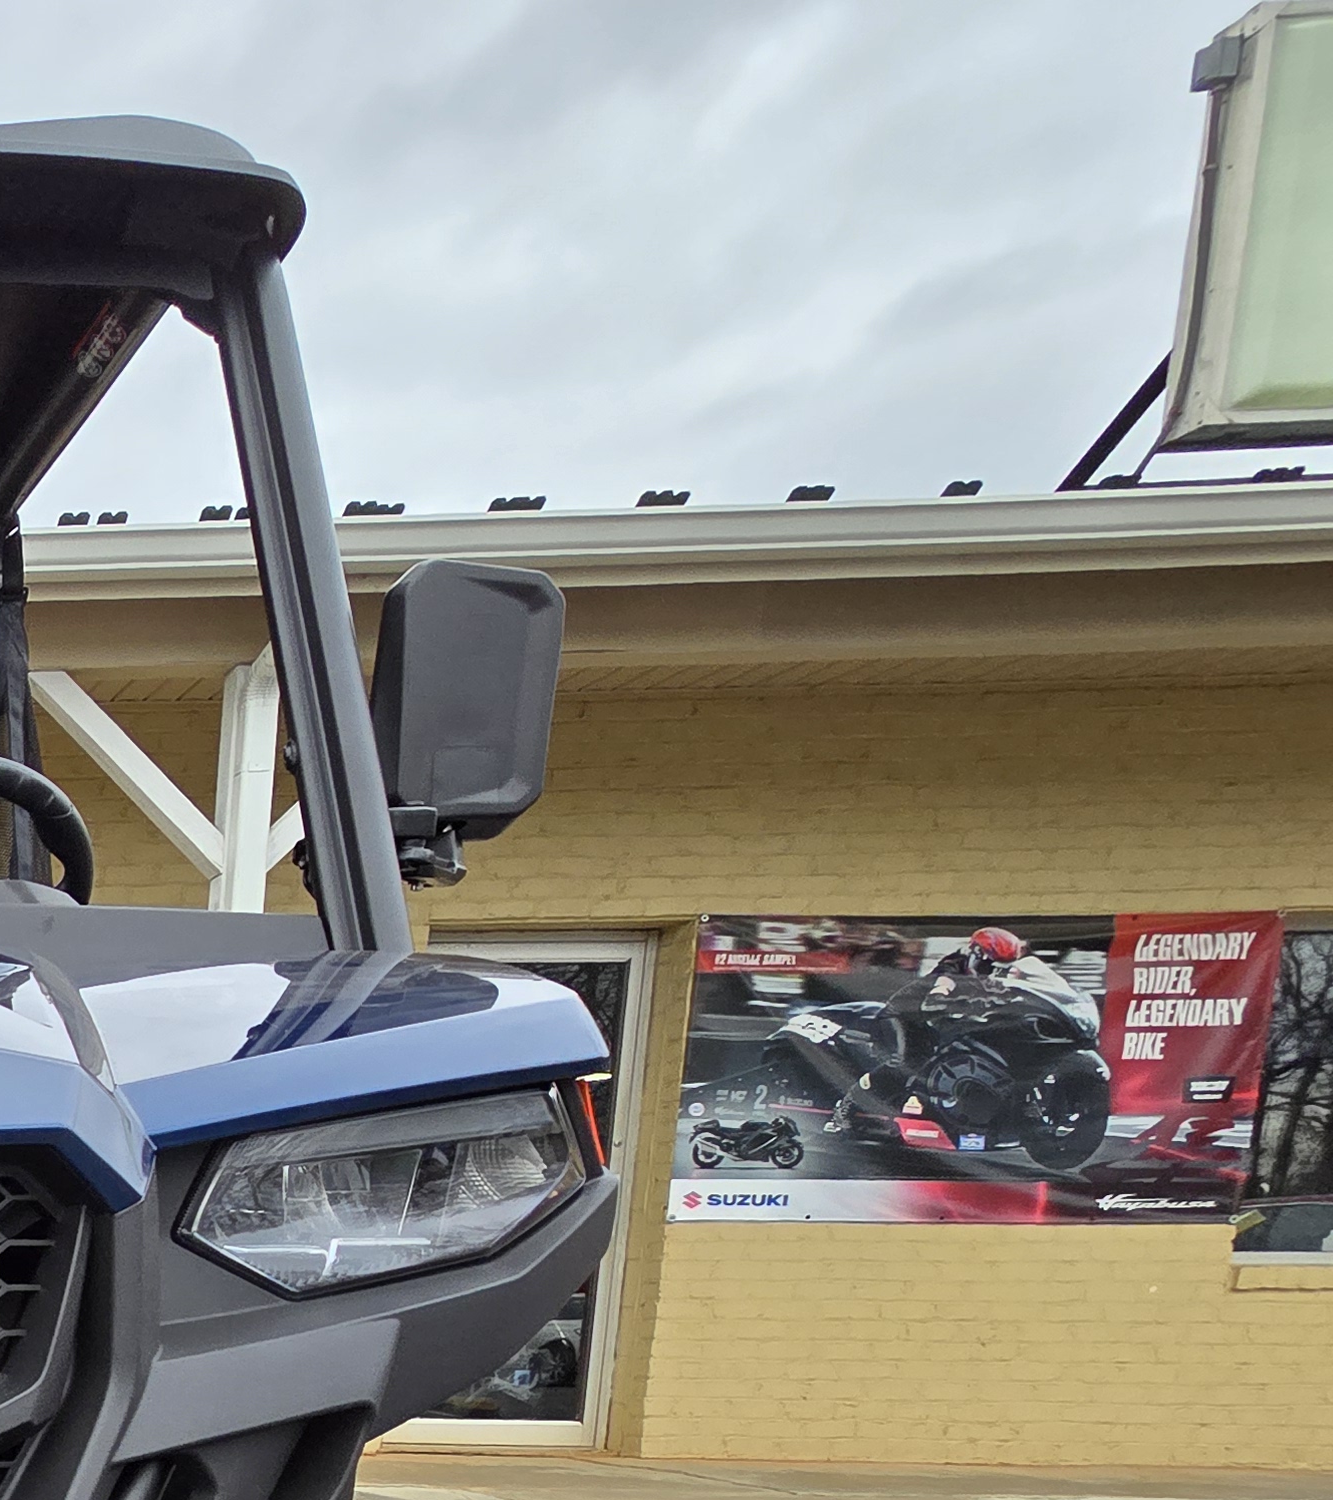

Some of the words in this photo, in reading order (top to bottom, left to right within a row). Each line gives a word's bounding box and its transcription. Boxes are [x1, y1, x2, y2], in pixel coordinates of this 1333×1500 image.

[1134, 931, 1257, 962] LEGENDARY
[1132, 966, 1197, 996] RIDER,
[1125, 997, 1248, 1028] LEGENDARY
[1121, 1032, 1168, 1060] BIKE
[753, 1084, 768, 1110] 2
[707, 1193, 789, 1207] SUZUKI
[1095, 1193, 1220, 1211] Hayabusa
